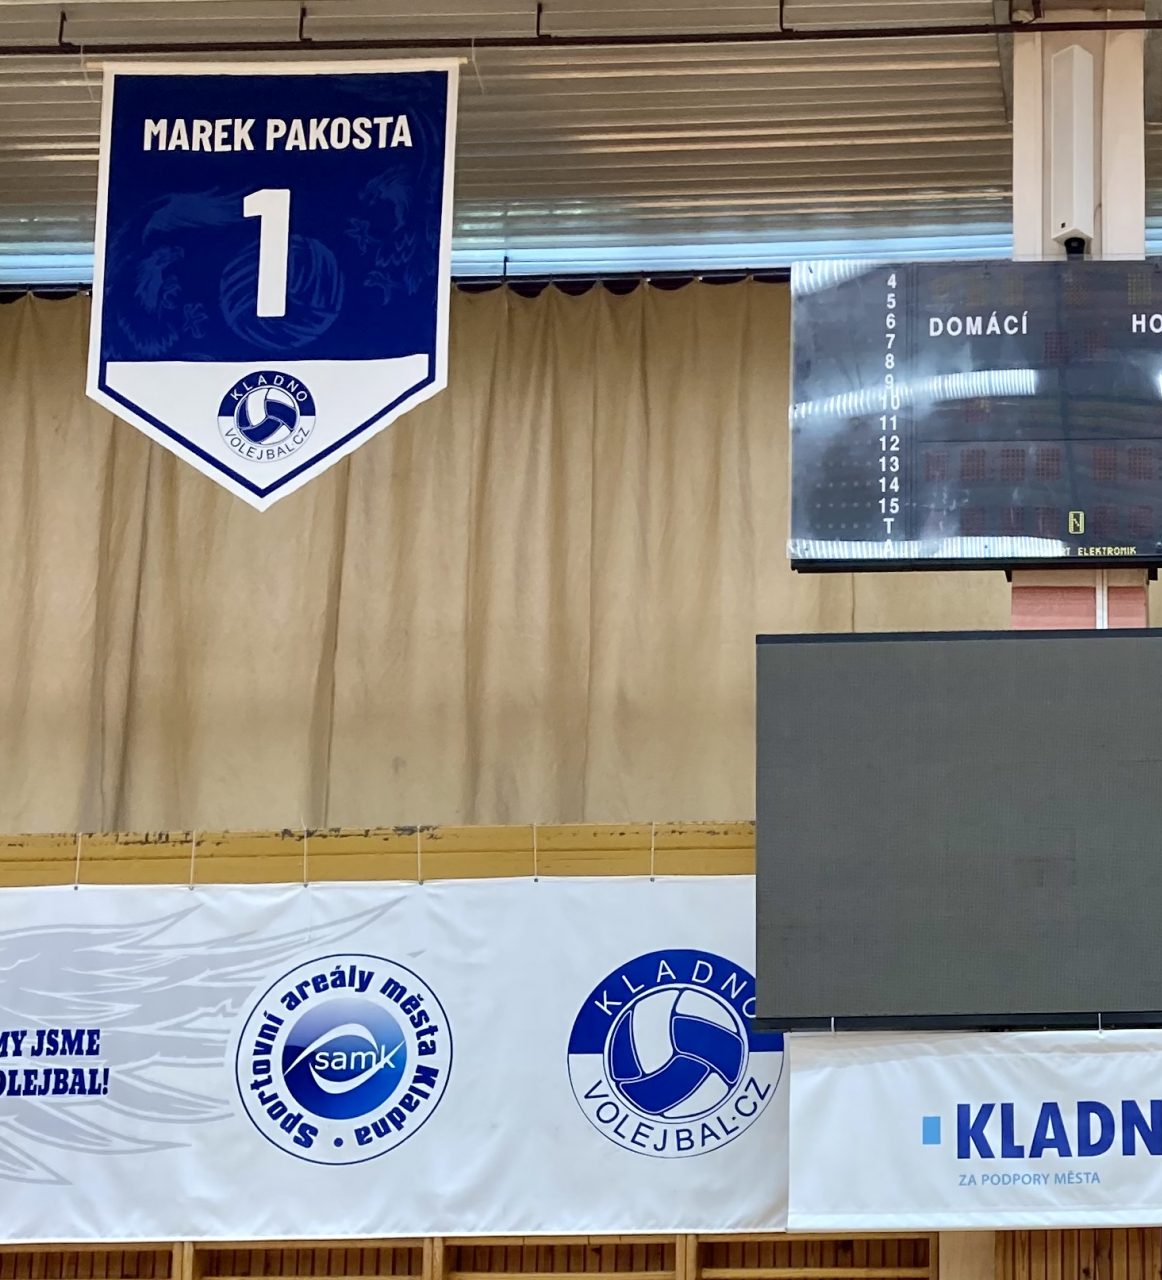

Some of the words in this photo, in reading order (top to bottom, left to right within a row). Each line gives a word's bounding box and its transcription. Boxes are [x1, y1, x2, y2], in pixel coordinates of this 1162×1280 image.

[143, 118, 255, 152] MAREK
[266, 115, 413, 151] PAKOSTA
[244, 188, 291, 317] 1
[887, 273, 897, 288] 4
[886, 293, 896, 309] 5
[886, 313, 896, 329] 6
[928, 311, 1028, 337] DOMÁCÍ
[885, 333, 896, 349] 7
[885, 353, 895, 369] 8
[229, 374, 308, 401] KLADNO
[879, 415, 897, 431] 11
[879, 435, 900, 451] 12
[879, 456, 900, 472] 13
[879, 476, 900, 493] 14
[878, 497, 900, 514] 15
[883, 517, 895, 534] T
[280, 965, 375, 1011] areály
[379, 977, 439, 1057] města
[31, 1029, 101, 1056] JSME
[314, 1045, 396, 1070] samk
[250, 1010, 319, 1149] Sportovní
[354, 1064, 440, 1146] Kladna
[958, 1174, 977, 1186] ZA
[981, 1172, 1050, 1186] PODPORY
[1054, 1169, 1101, 1185] MĚSTA
